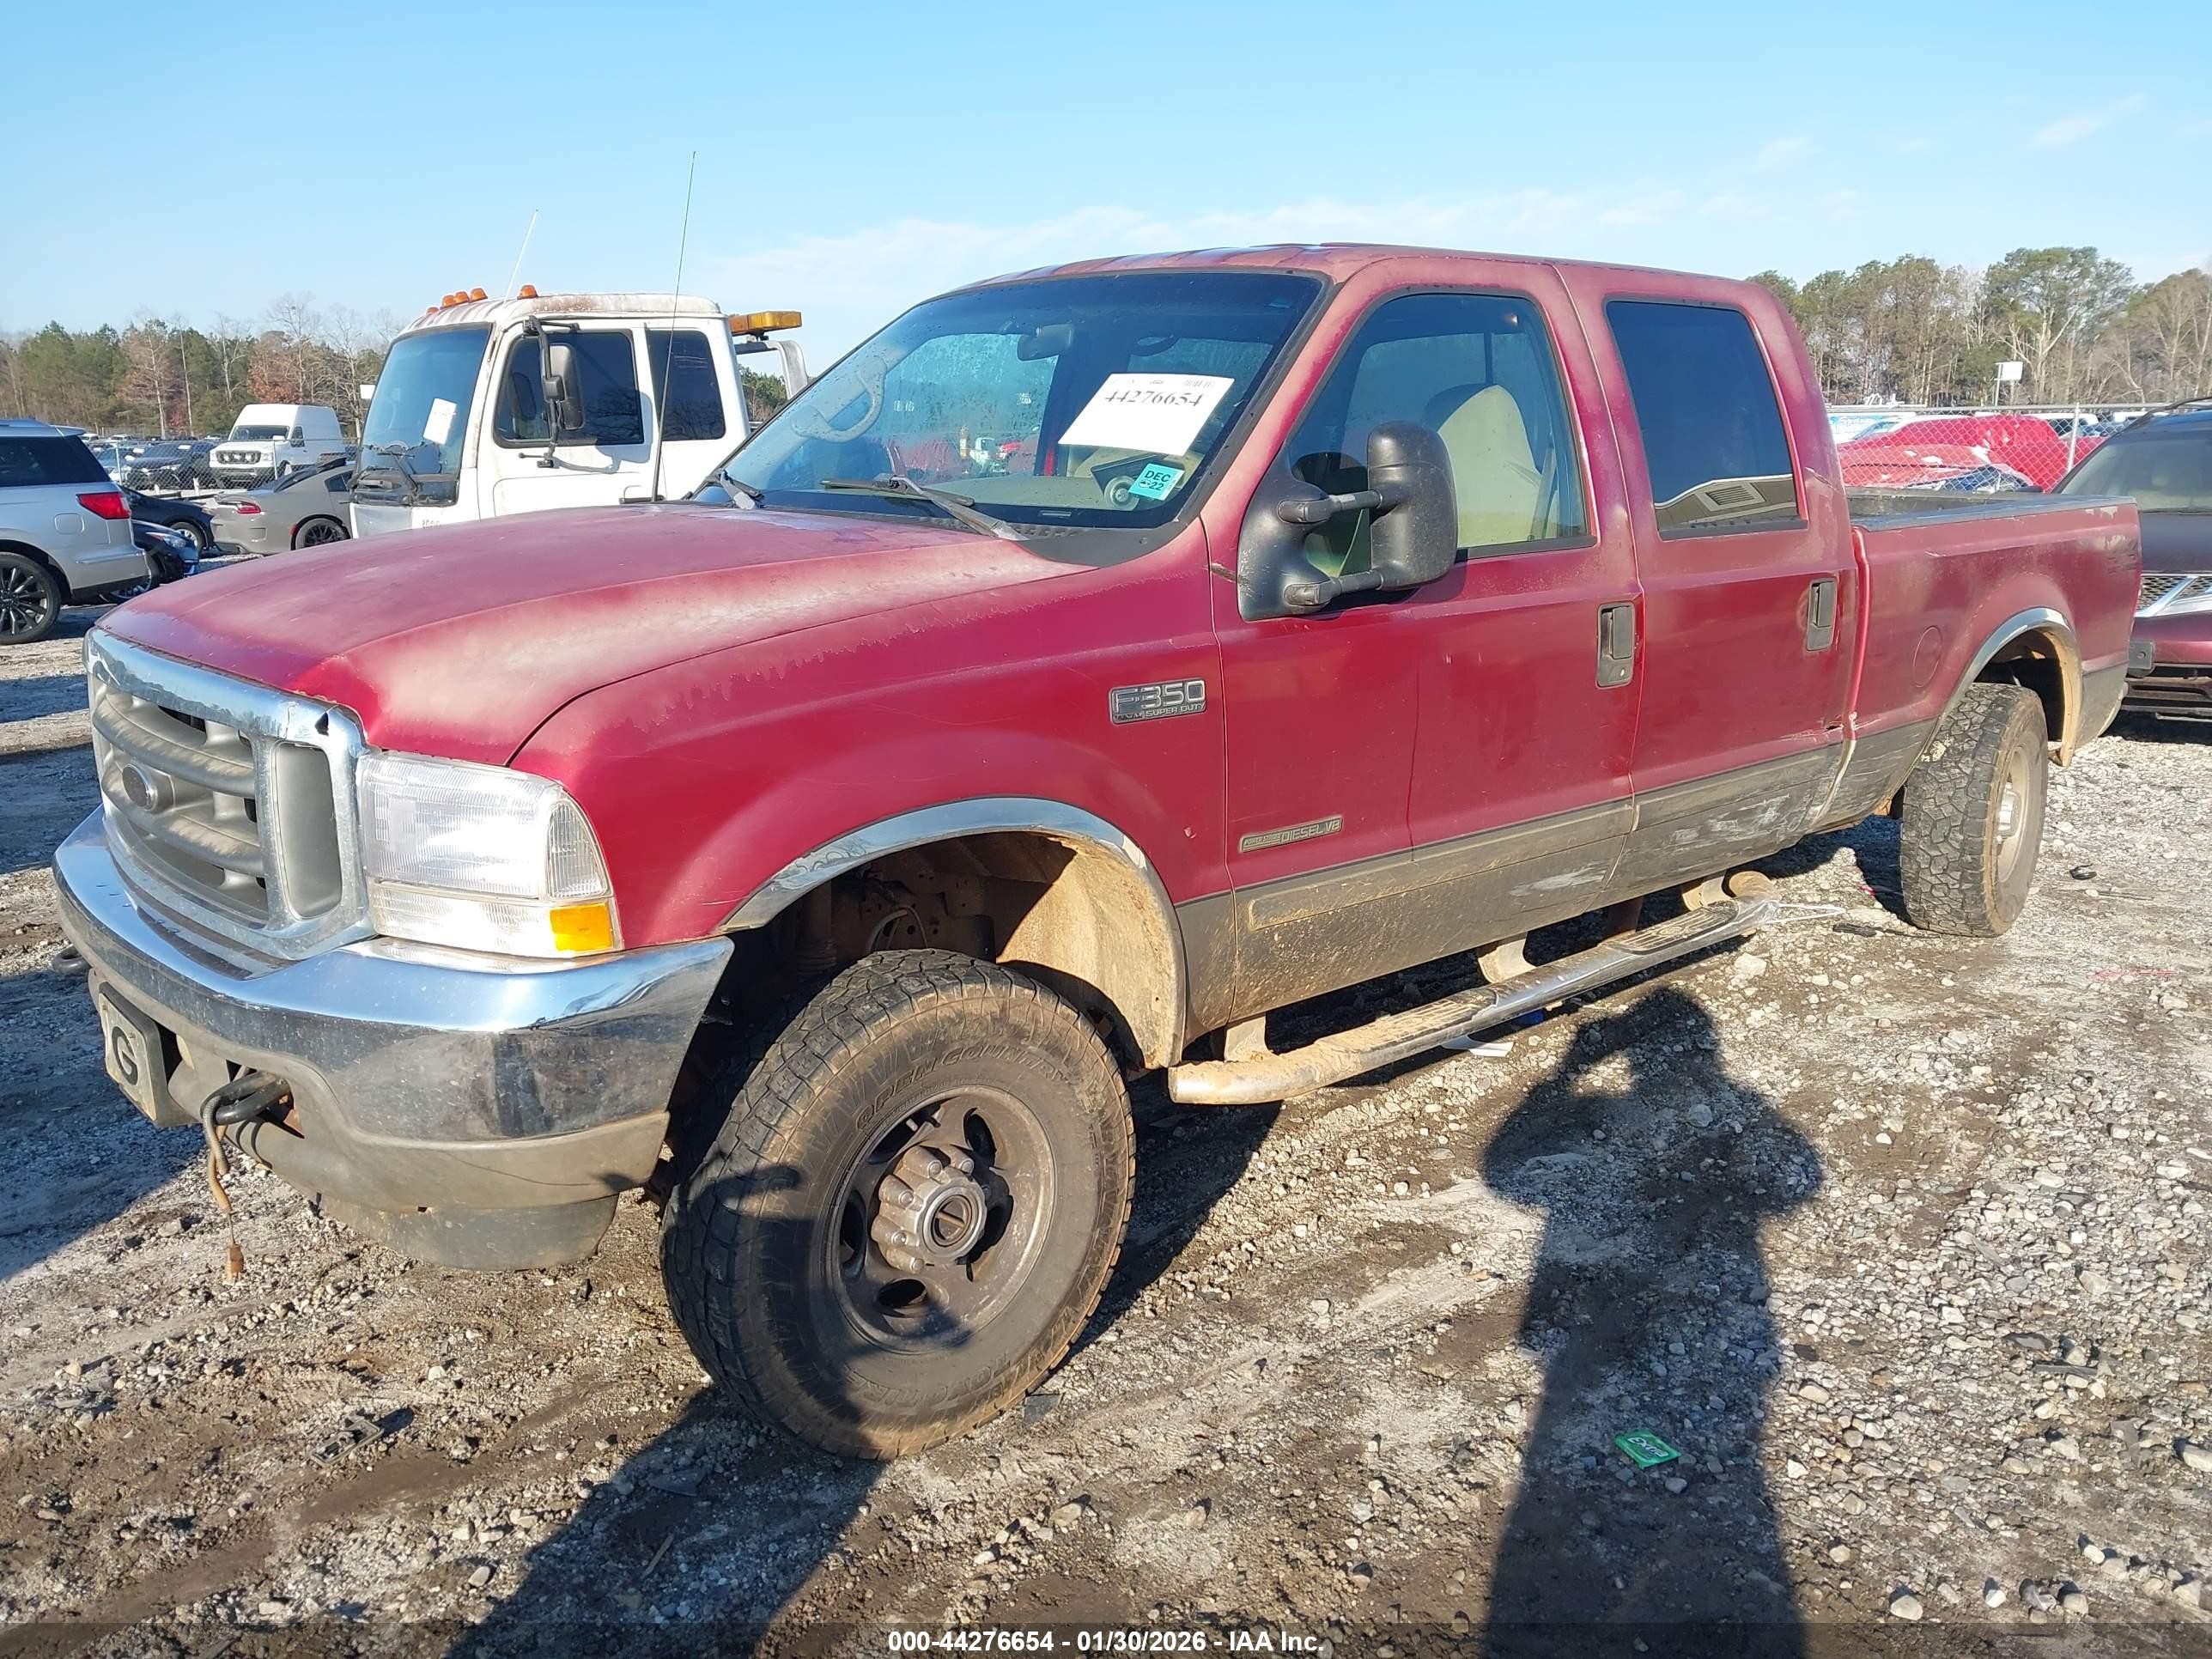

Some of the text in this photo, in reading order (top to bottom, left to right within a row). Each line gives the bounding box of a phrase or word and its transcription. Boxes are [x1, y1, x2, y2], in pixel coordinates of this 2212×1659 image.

[1104, 390, 1204, 406] 44276654
[1144, 470, 1171, 483] DEC
[1149, 481, 1164, 491] 22
[1146, 707, 1178, 717] SUPER
[1180, 700, 1206, 712] DUTY
[1280, 823, 1323, 843] DIESEL
[1324, 818, 1340, 833] V8
[112, 1025, 139, 1086] G
[856, 1056, 937, 1131] OPEN
